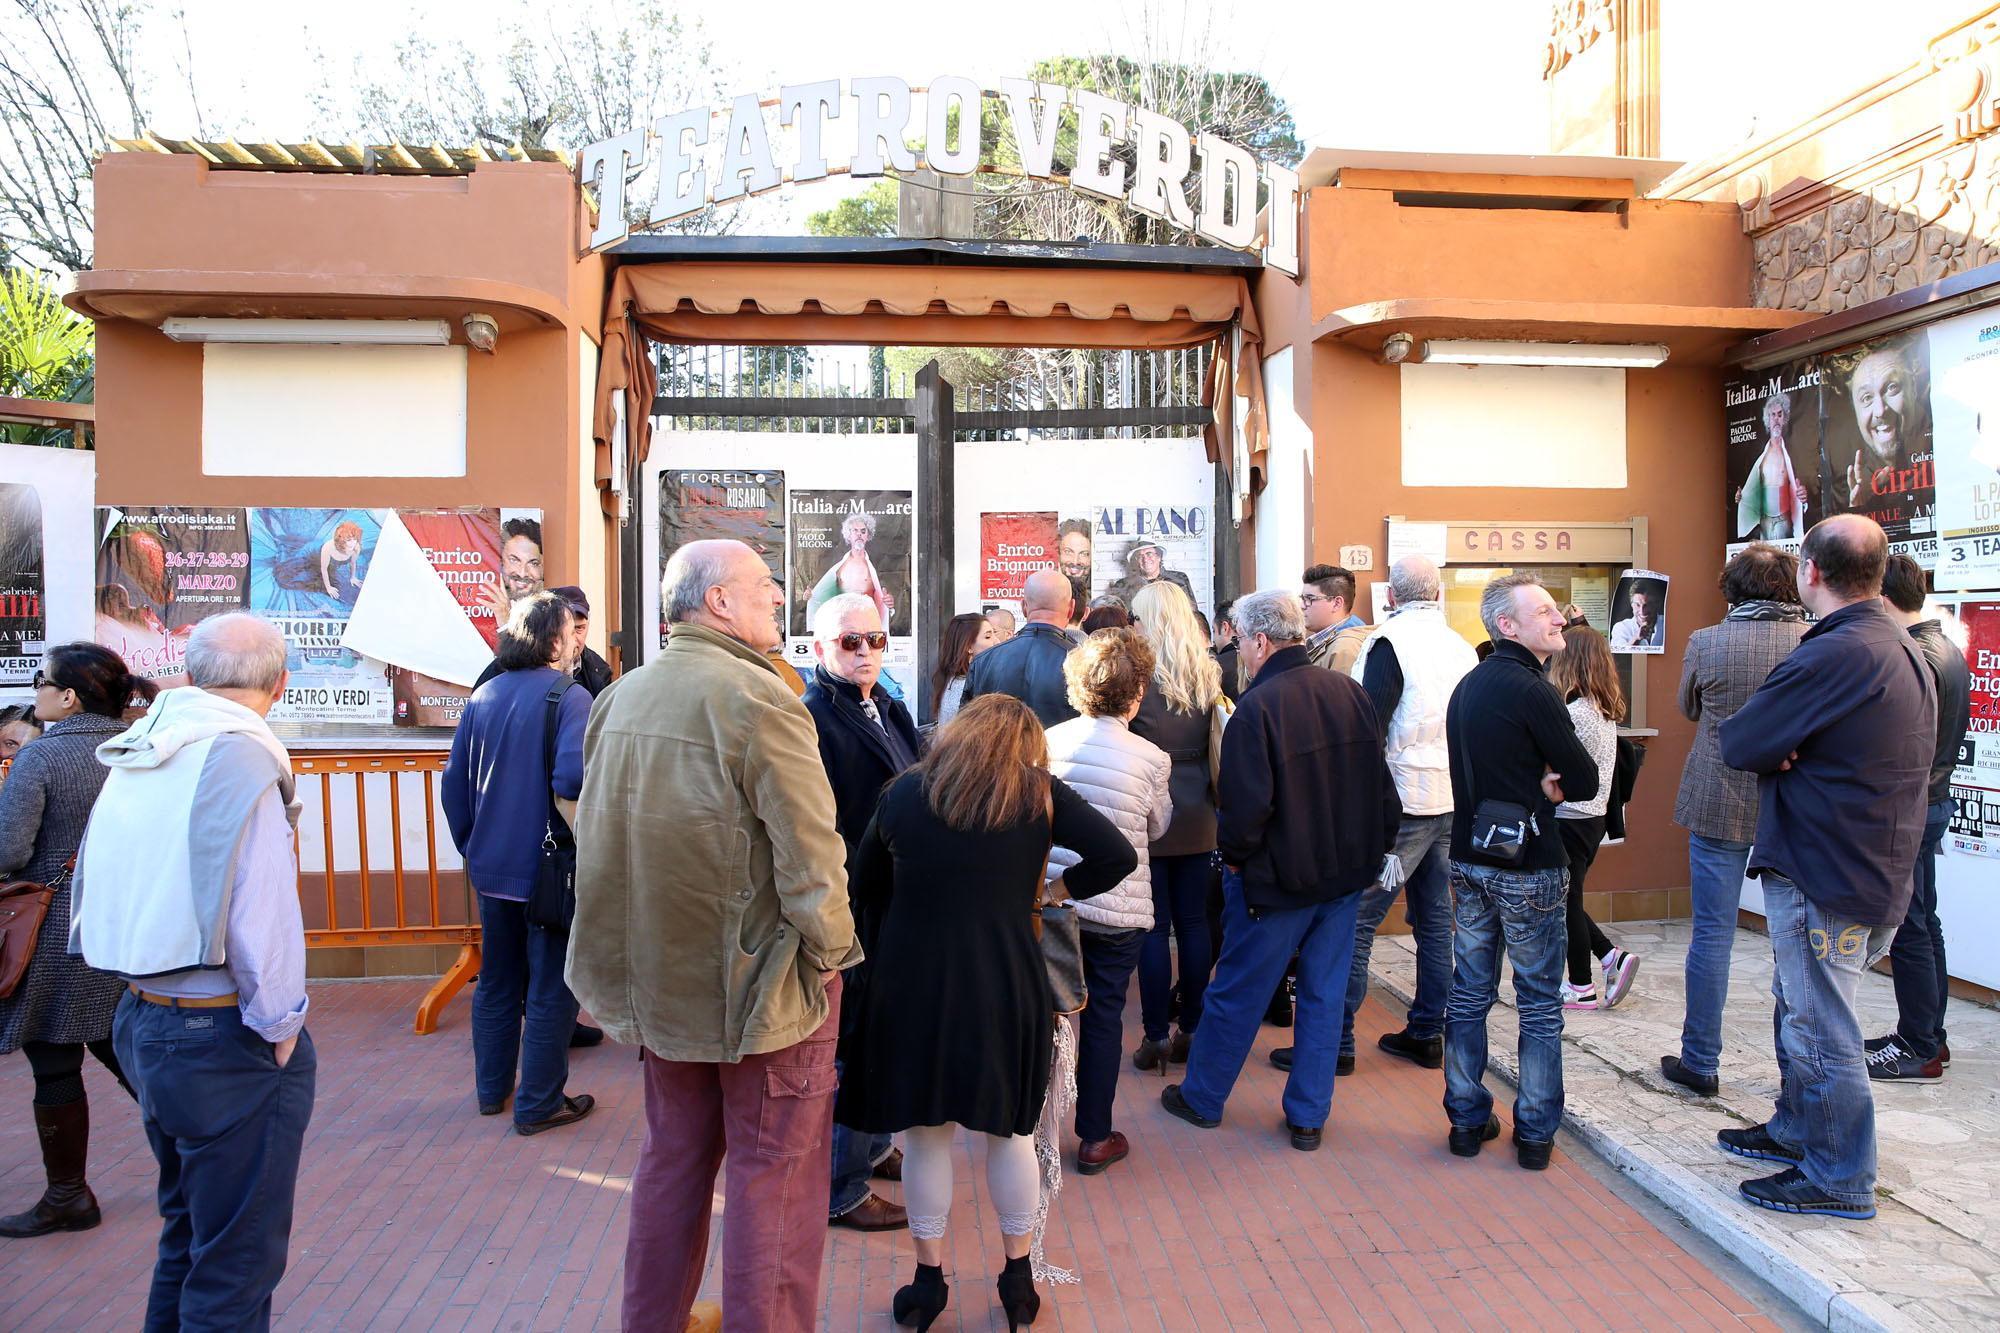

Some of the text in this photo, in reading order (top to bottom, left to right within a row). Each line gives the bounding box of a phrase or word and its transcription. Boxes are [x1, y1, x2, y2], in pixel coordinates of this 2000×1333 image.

[581, 75, 1300, 283] TEATRO VERDI
[1725, 384, 1757, 407] Italia
[1758, 386, 1768, 399] di
[1730, 424, 1752, 436] PAOLO
[1730, 432, 1757, 444] MIGONE
[727, 488, 766, 508] ROSARIO
[791, 498, 834, 514] Italia
[836, 503, 848, 515] di
[1914, 506, 1922, 518] A
[1096, 507, 1204, 536] AL BANO
[797, 533, 826, 541] PAOLO
[1968, 525, 2000, 535] INGRESSO
[797, 541, 833, 549] MIGONE
[1465, 530, 1571, 551] CASSA
[1913, 540, 1938, 552] VER
[997, 543, 1045, 557] Enrico
[1951, 547, 1966, 561] 3
[165, 551, 249, 568] 26-27-28-29
[987, 557, 1055, 575] Brignano
[177, 574, 237, 590] MARZO
[15, 631, 41, 641] ME!
[311, 649, 339, 657] LIVE
[794, 644, 809, 655] 8
[333, 690, 370, 705] VERDI
[1957, 745, 1968, 760] 9
[1949, 816, 1982, 832] APRILE
[1808, 924, 1872, 960] 96
